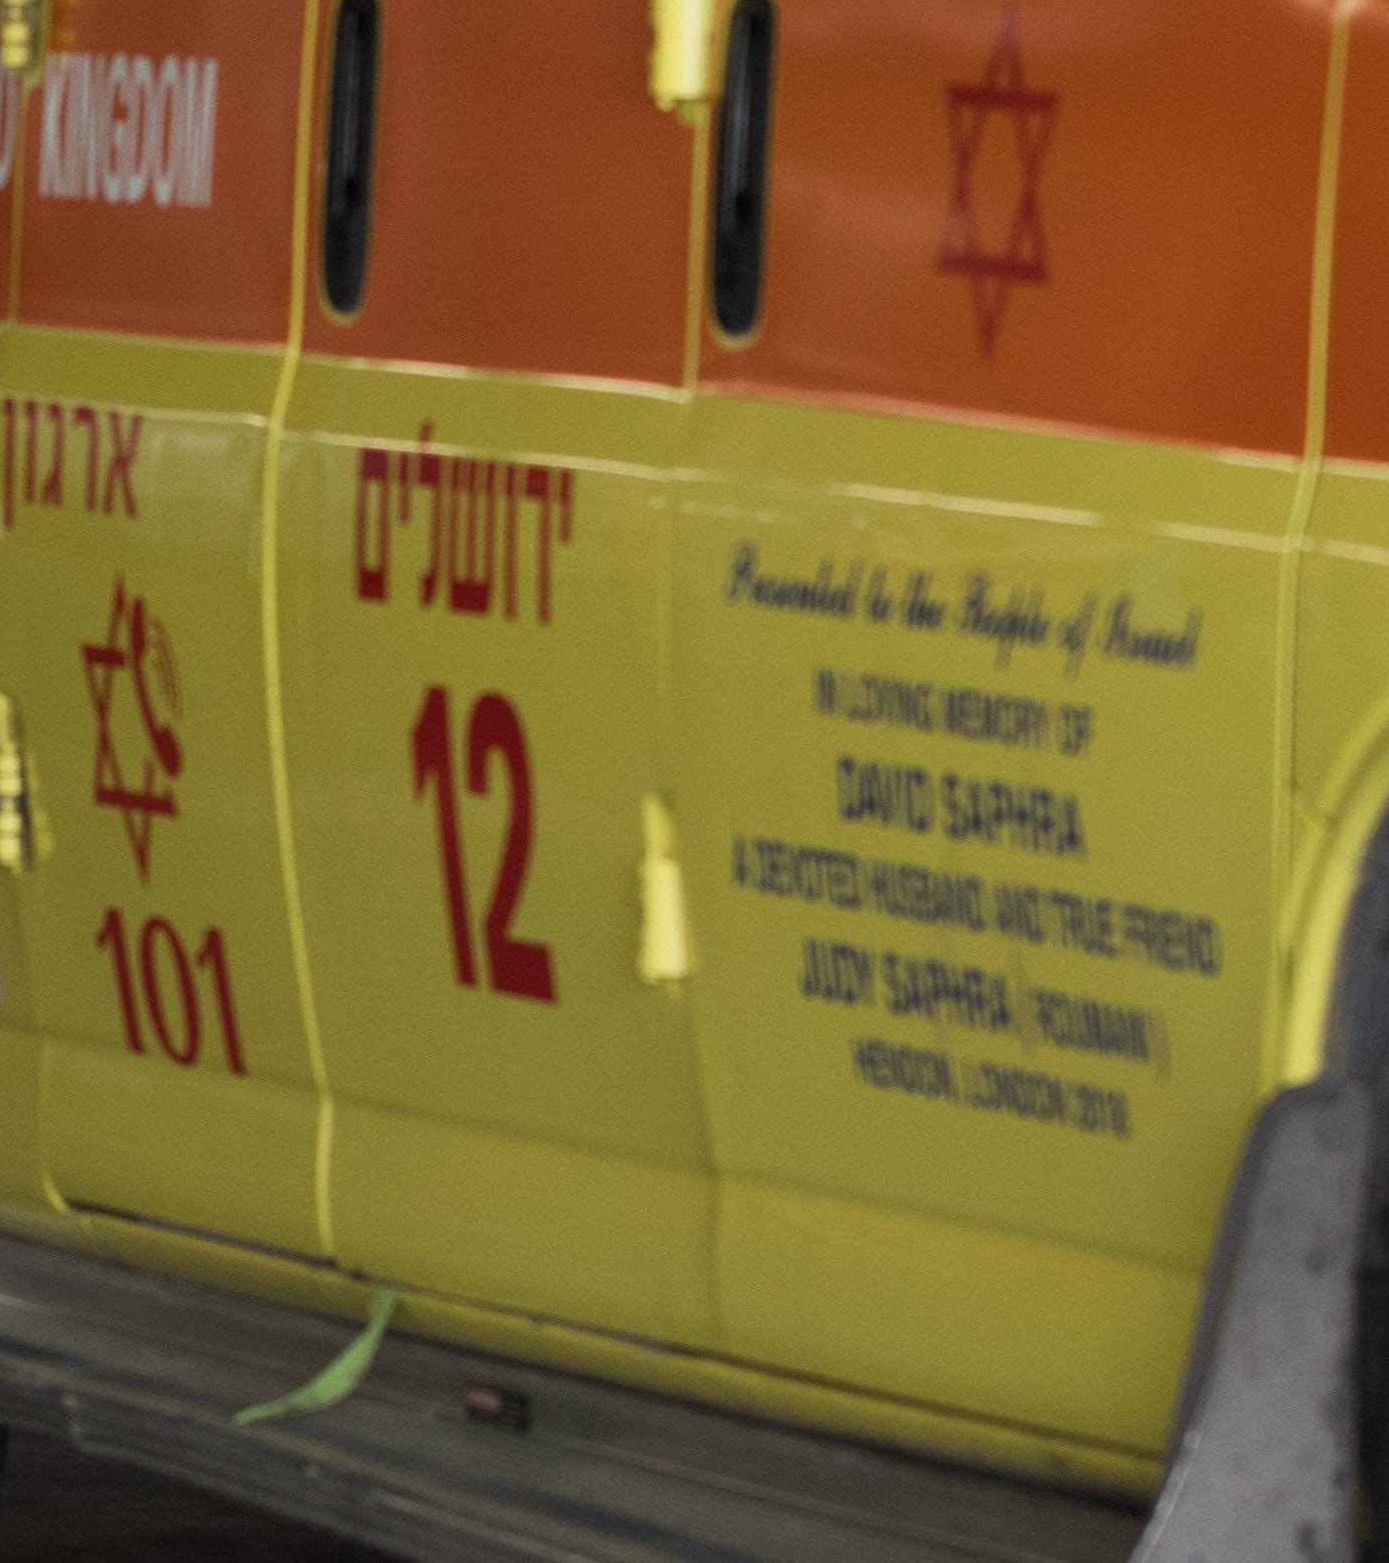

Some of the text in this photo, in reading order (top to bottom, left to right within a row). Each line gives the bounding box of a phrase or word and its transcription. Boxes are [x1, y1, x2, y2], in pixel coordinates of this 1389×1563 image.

[38, 51, 219, 209] KINGDOM
[1, 397, 146, 528] ארגון
[354, 419, 575, 626] ירושלים
[723, 539, 864, 620] Presented
[864, 558, 892, 626] to
[904, 567, 948, 631] the
[1059, 589, 1100, 681] of
[842, 672, 934, 734] LOVING
[942, 686, 1050, 750] MEMORY
[411, 684, 560, 1006] 12
[836, 752, 935, 833] DAVID
[752, 836, 864, 912] DEVOTED
[867, 858, 988, 934] HUSBAND
[992, 882, 1046, 946] AND
[1045, 888, 1118, 960] TRUE
[1120, 902, 1224, 980] FRIEND
[799, 938, 877, 1009] JUDY
[95, 907, 249, 1078] 101
